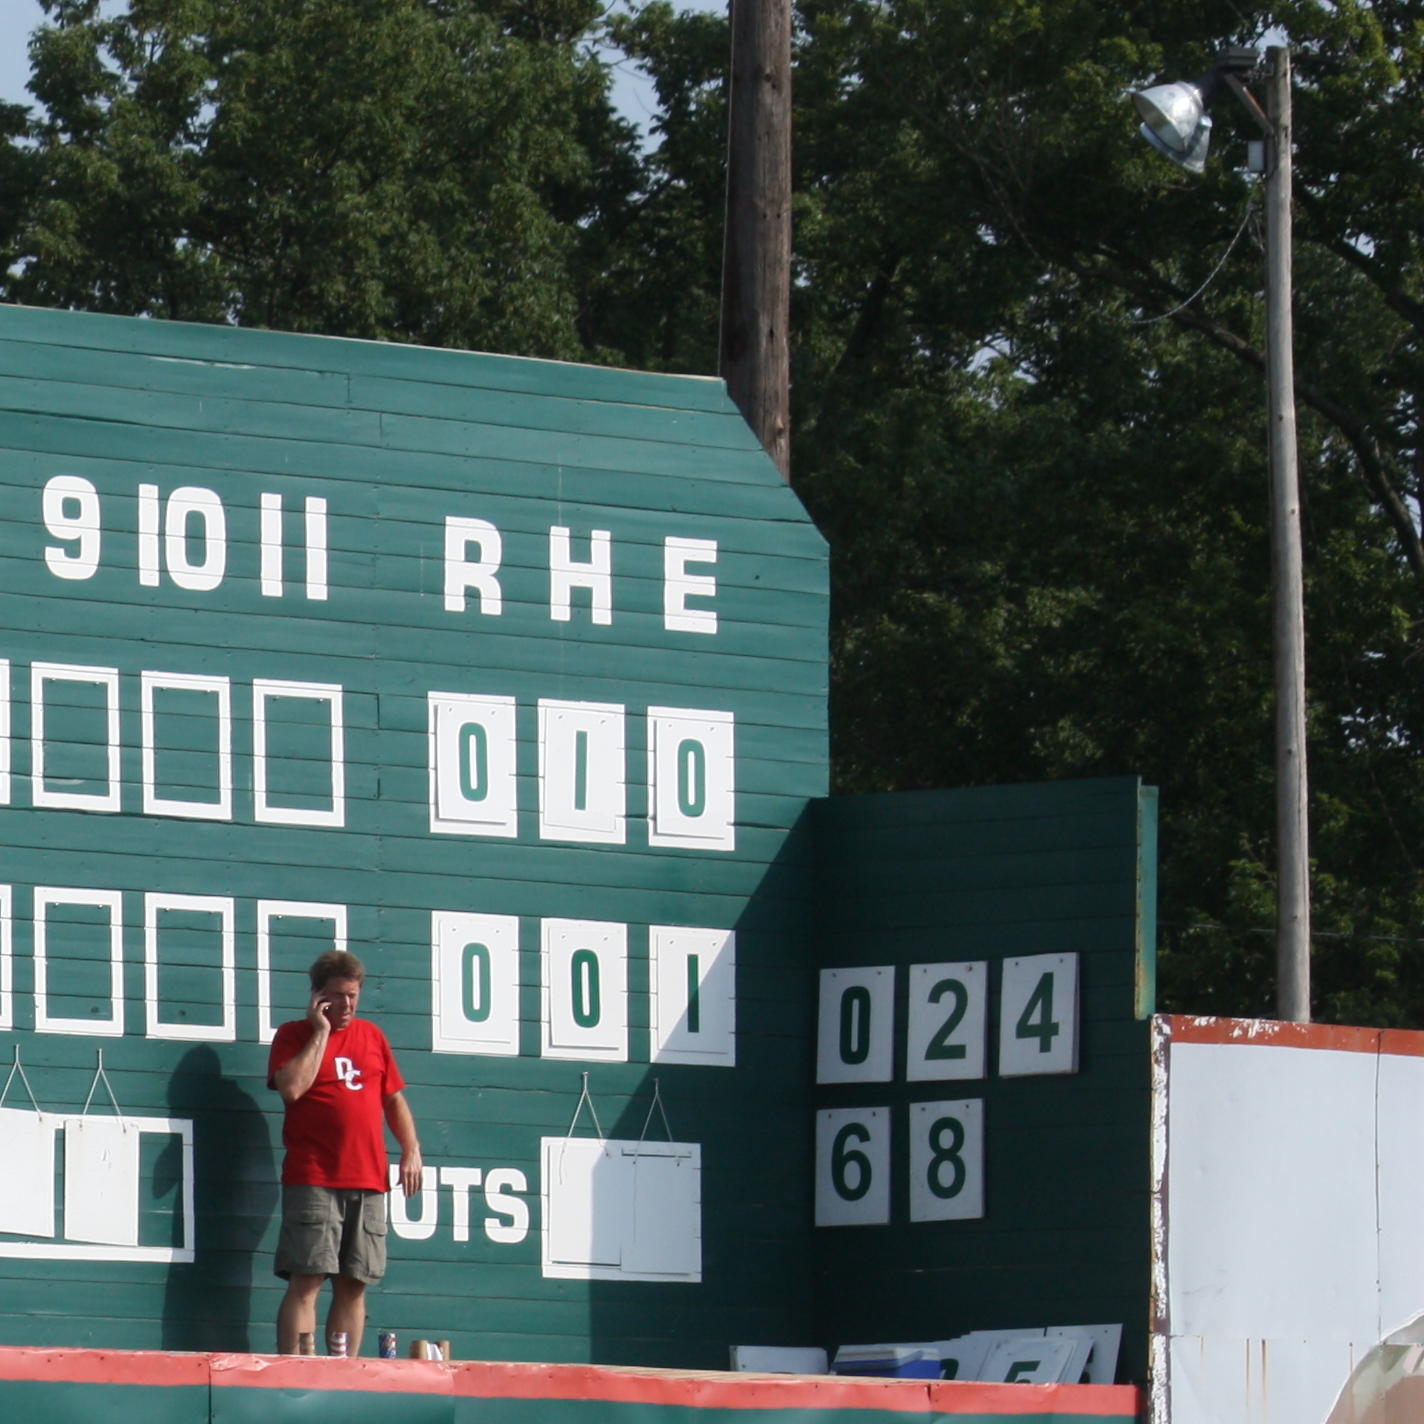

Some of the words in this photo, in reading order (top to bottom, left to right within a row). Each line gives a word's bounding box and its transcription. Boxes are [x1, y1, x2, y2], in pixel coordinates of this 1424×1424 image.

[43, 476, 100, 579] 9
[139, 484, 226, 591] 10
[261, 493, 327, 600] 11
[444, 516, 502, 615] R
[550, 526, 612, 625] H
[664, 537, 717, 634] E
[925, 979, 968, 1060] 2
[1016, 972, 1059, 1052] 4
[335, 1058, 362, 1090] DC
[831, 1122, 872, 1202] 6
[927, 1117, 966, 1199] 8
[384, 1164, 530, 1243] UTS
